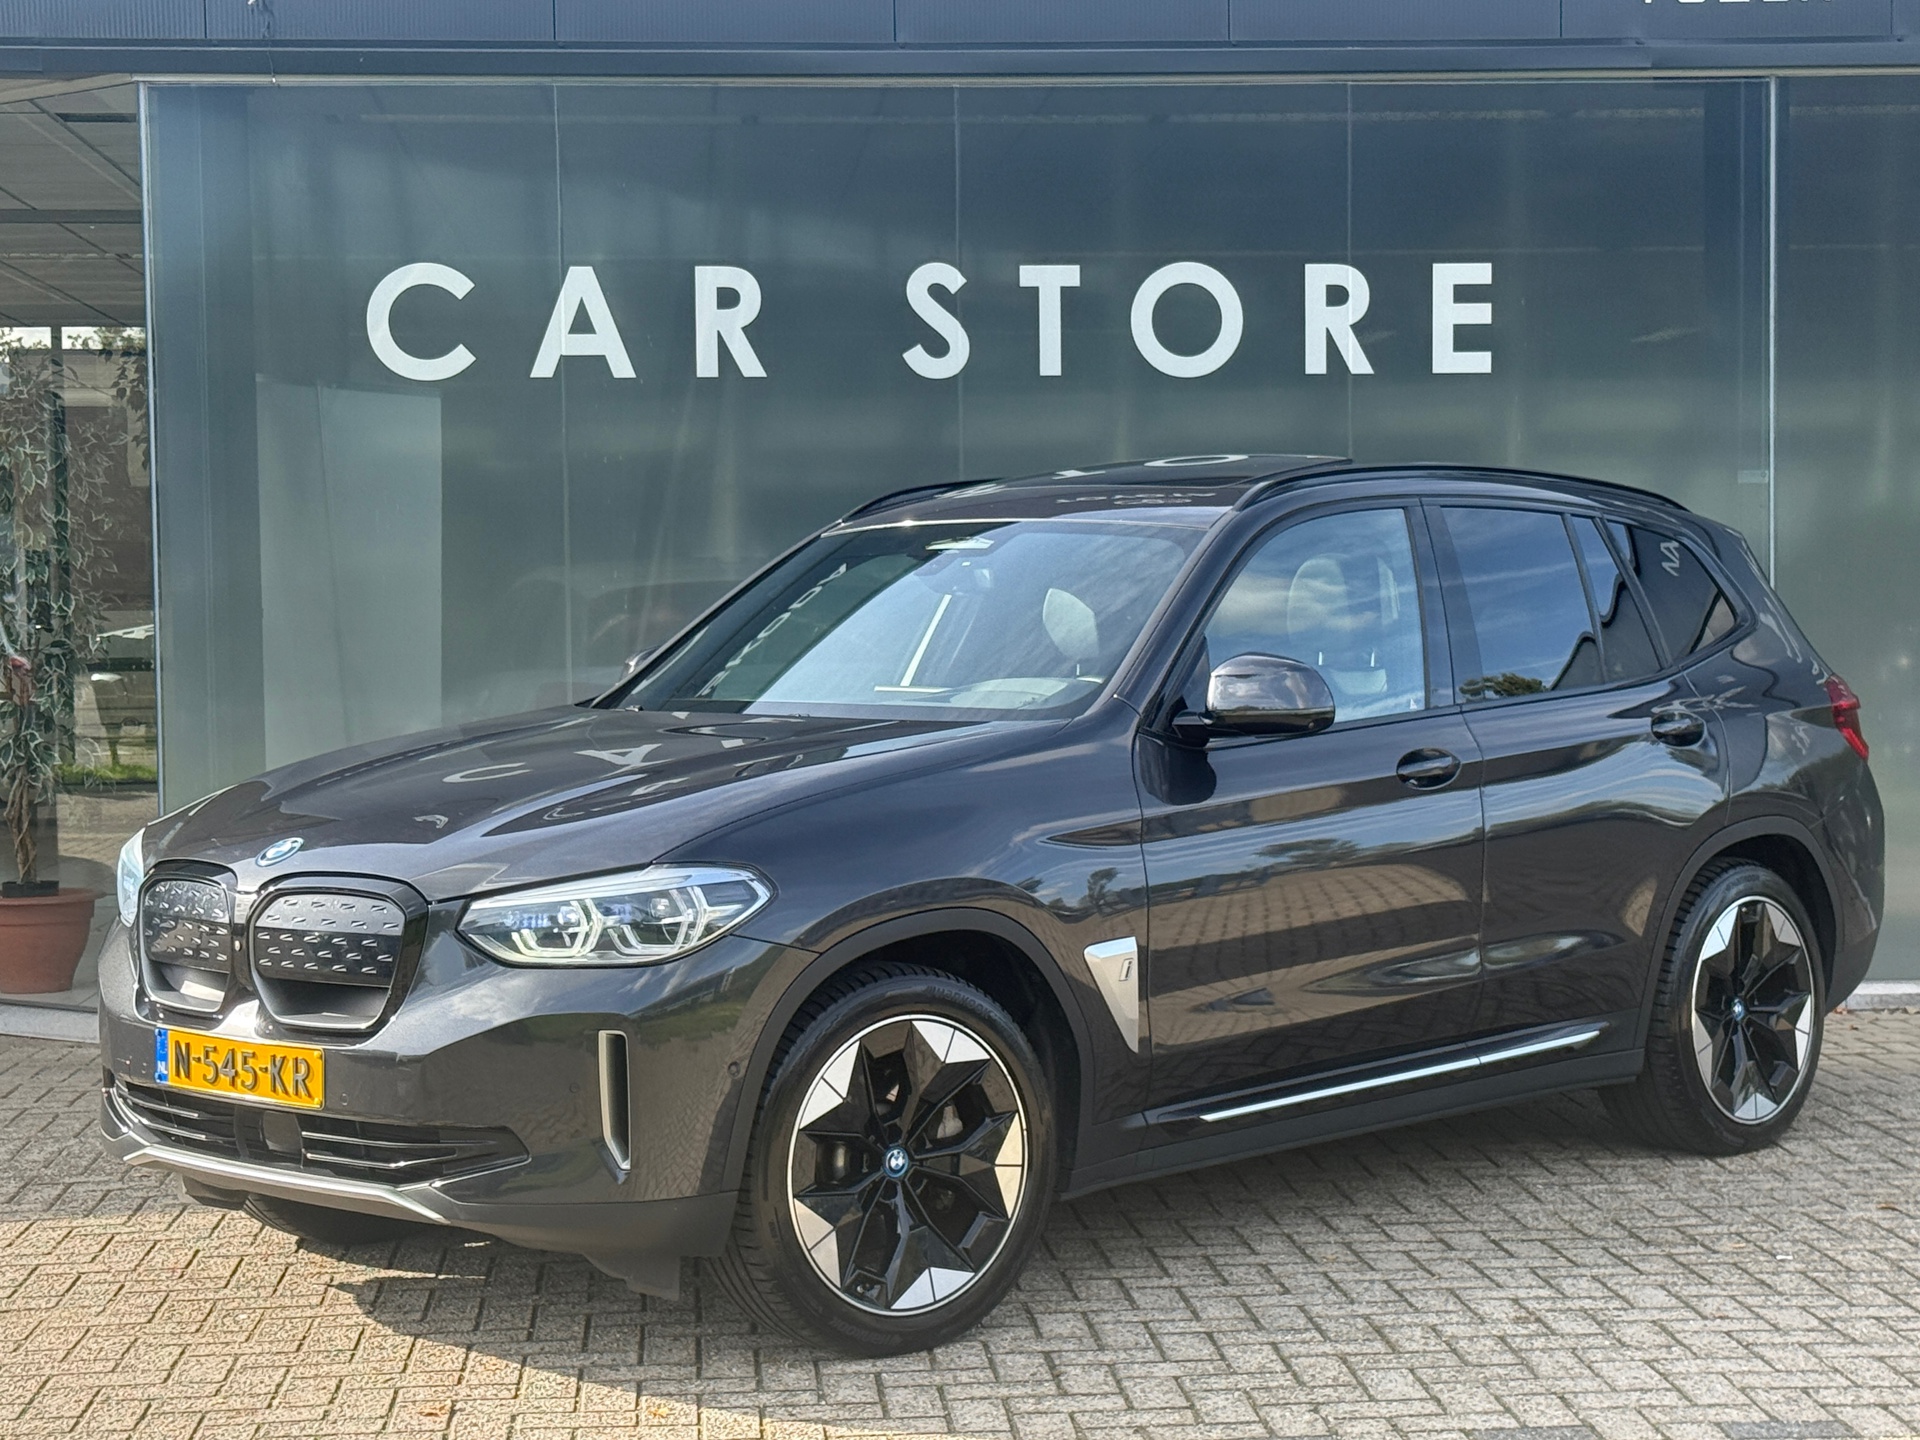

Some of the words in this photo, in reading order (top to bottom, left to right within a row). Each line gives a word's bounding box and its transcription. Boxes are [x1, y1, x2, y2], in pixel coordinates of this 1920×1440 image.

[366, 261, 768, 382] CAR
[901, 261, 1493, 380] STORE
[156, 1061, 168, 1074] NL
[174, 1040, 312, 1098] N-545-KR
